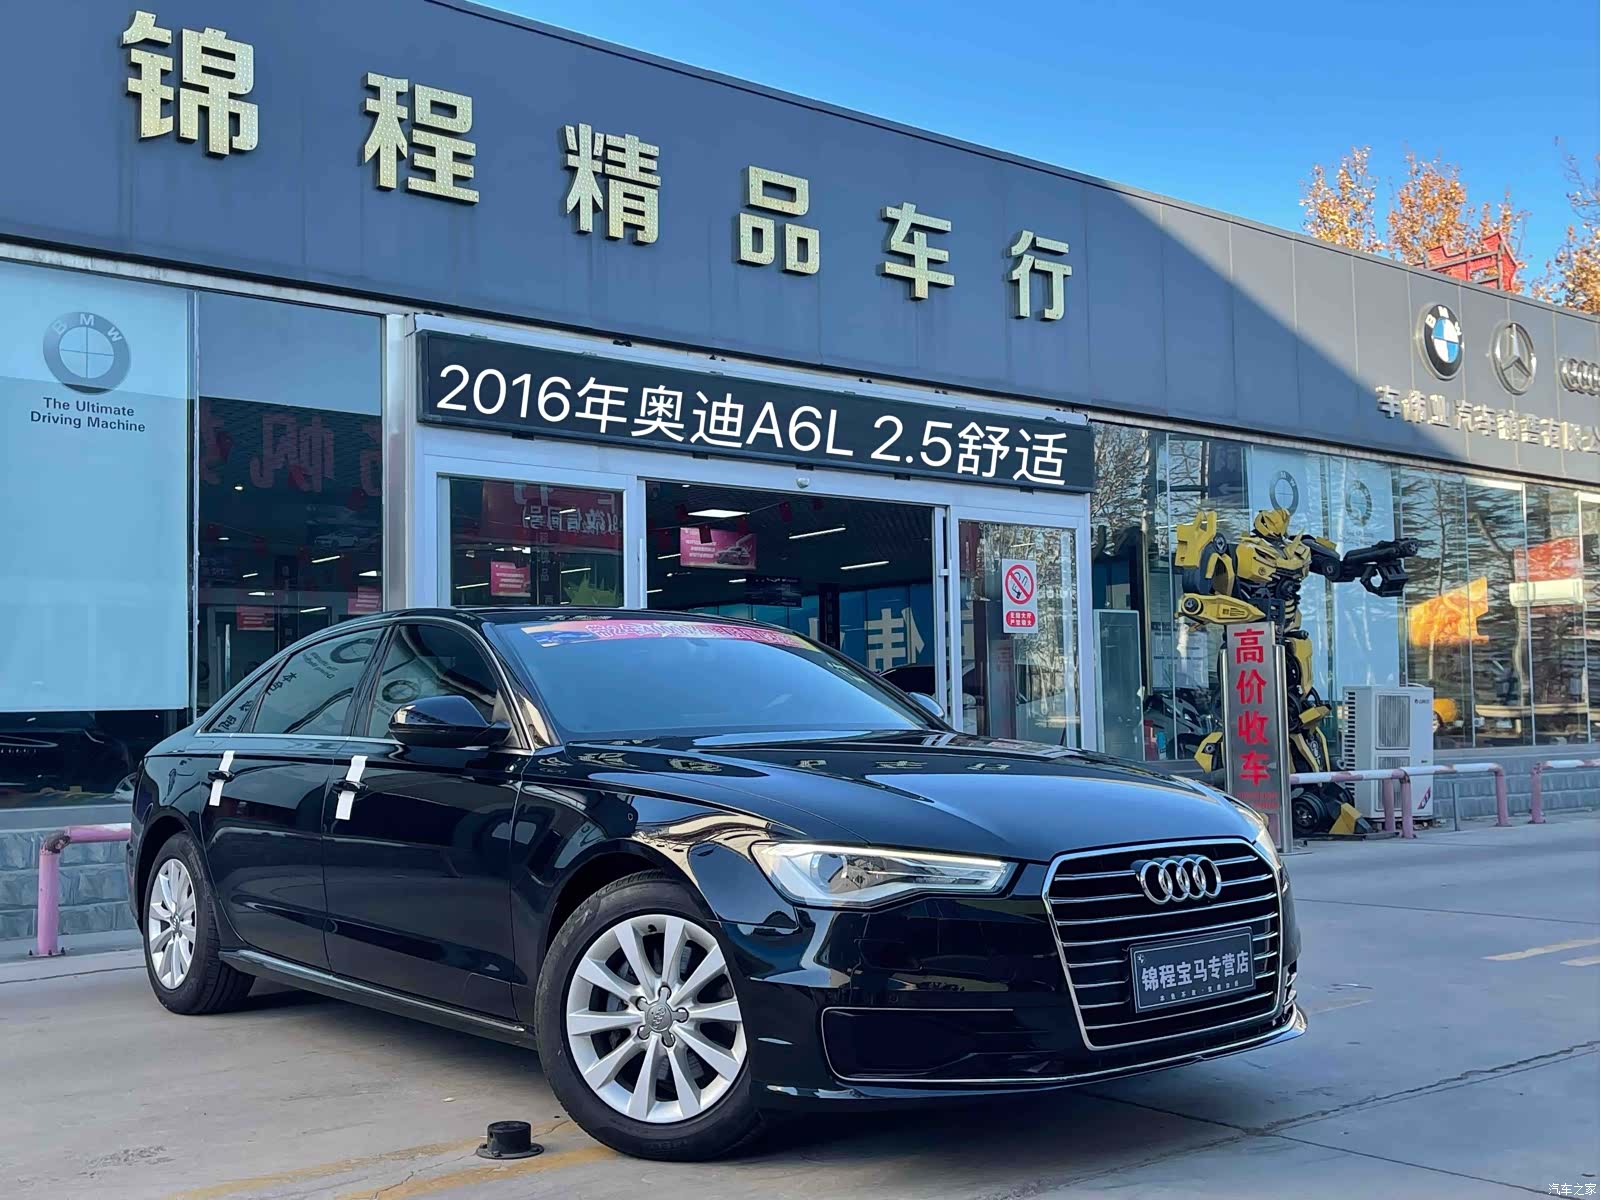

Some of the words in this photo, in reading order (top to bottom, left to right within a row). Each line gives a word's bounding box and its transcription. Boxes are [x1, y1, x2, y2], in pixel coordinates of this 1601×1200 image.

[118, 10, 1073, 321] 锦程精品车行
[51, 313, 122, 342] BMW
[30, 410, 81, 429] Driving
[87, 416, 146, 432] Machine
[43, 396, 70, 411] The
[76, 400, 135, 417] Ultimate
[436, 364, 854, 457] 2016年奥迪A6L
[869, 414, 1069, 486] 2.5舒适
[1233, 628, 1271, 786] 高价收车
[1141, 950, 1249, 992] 锦程宝马专营店
